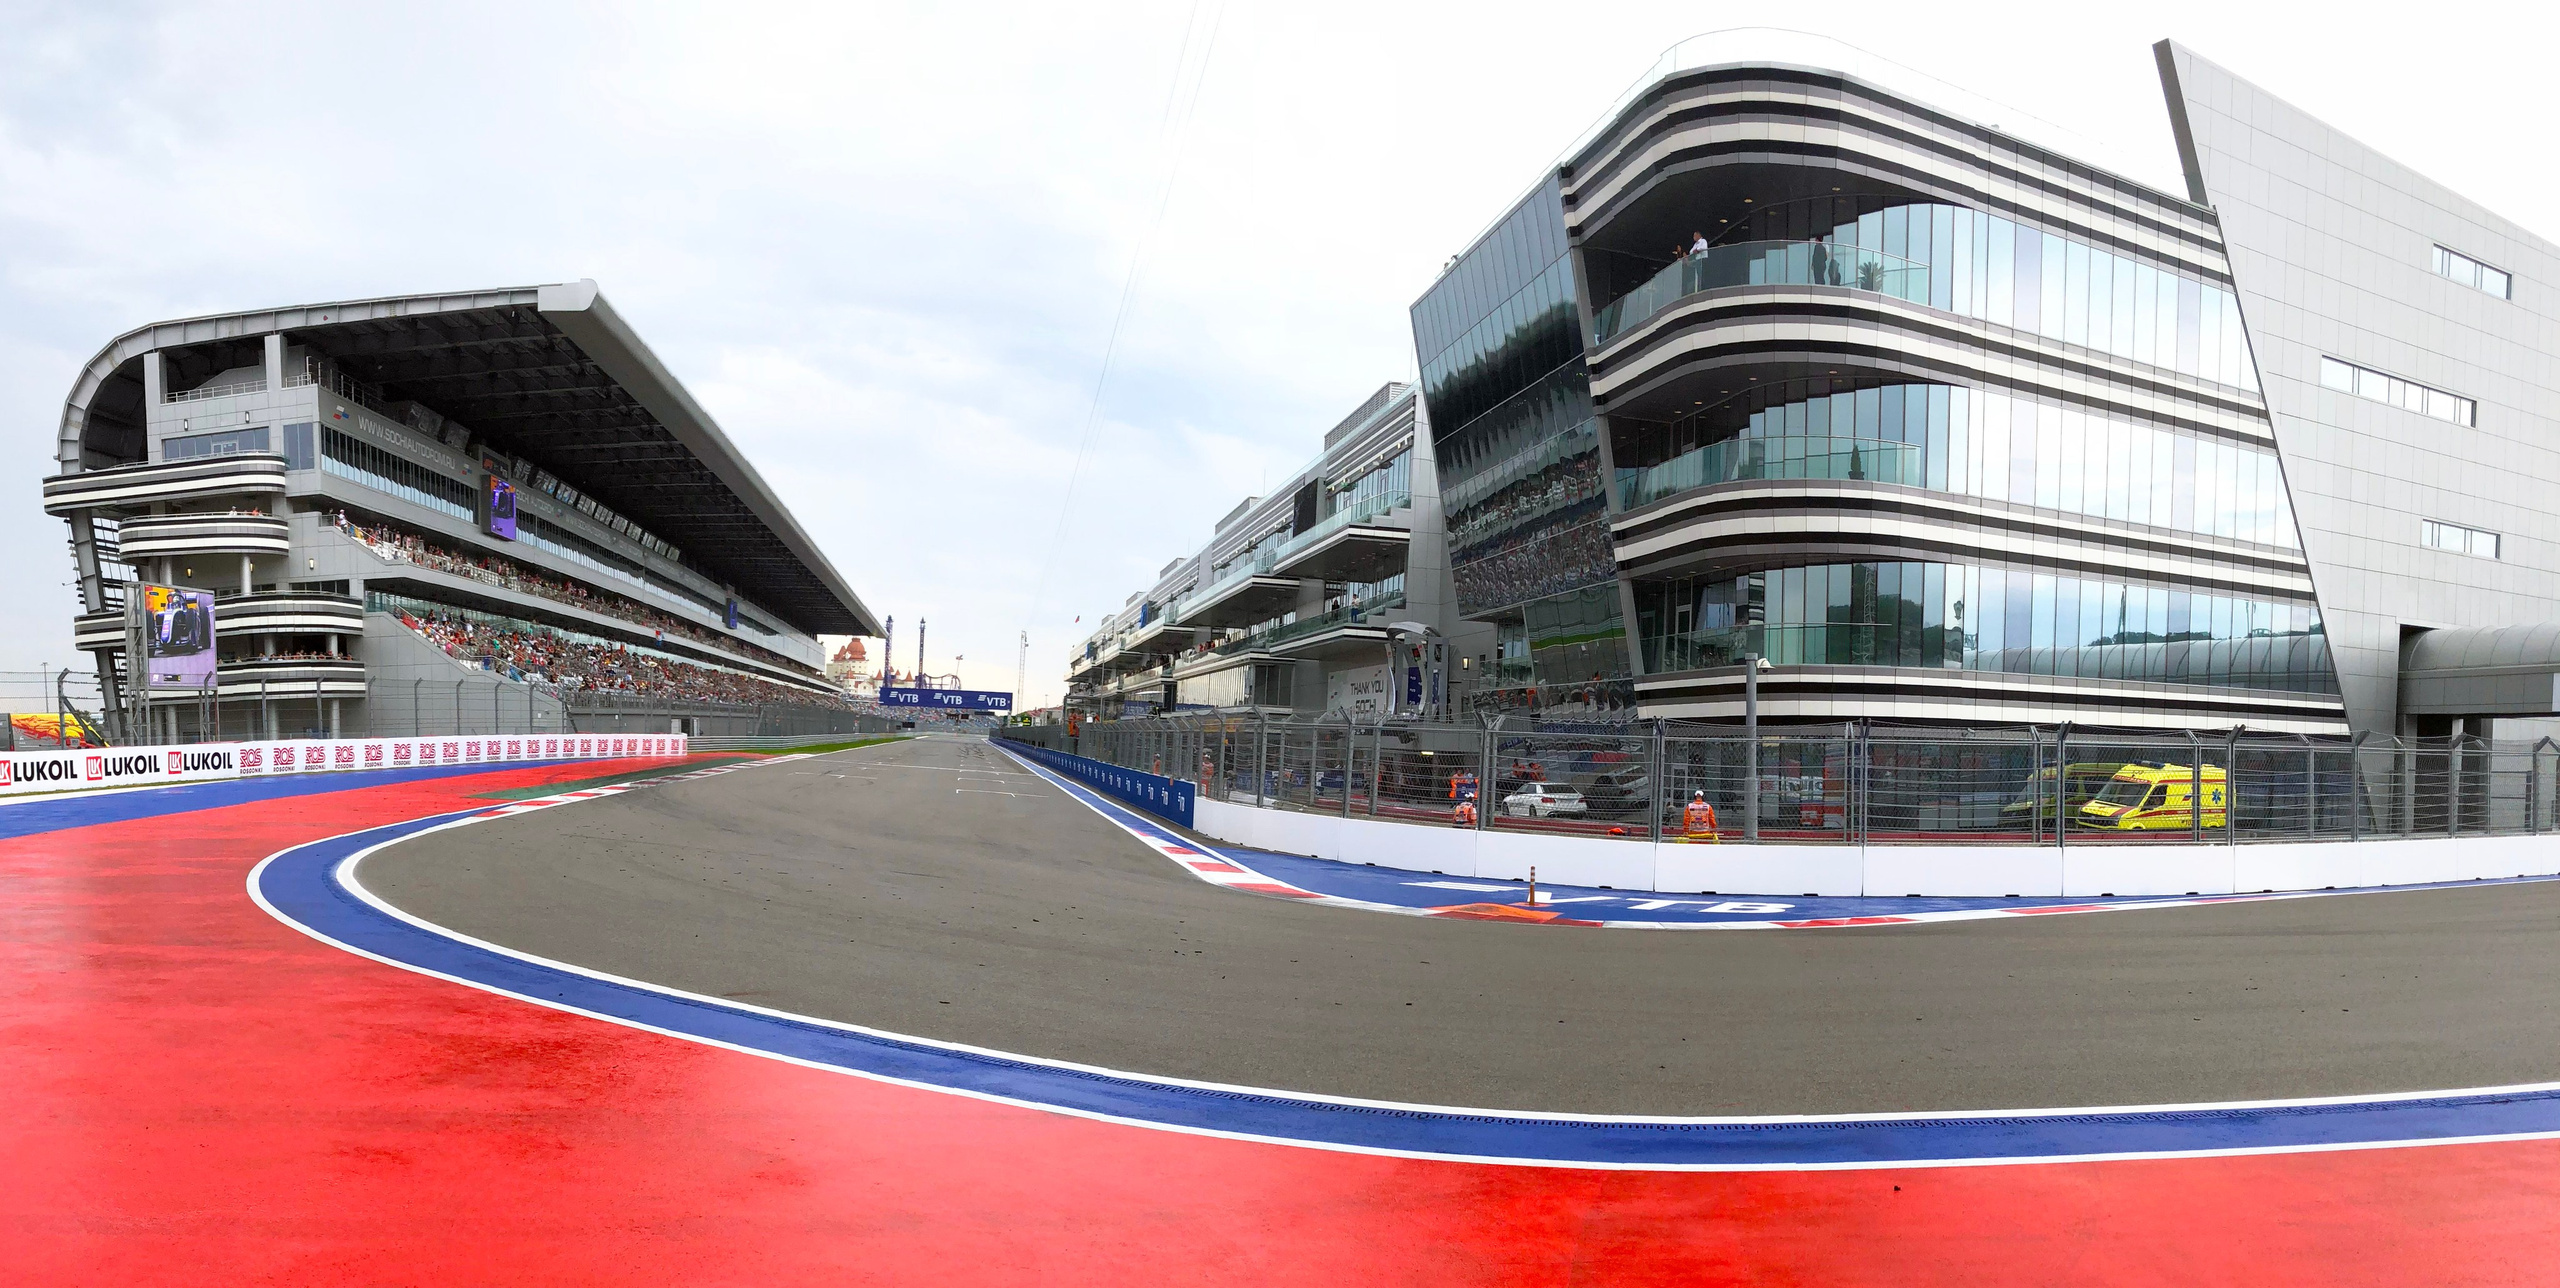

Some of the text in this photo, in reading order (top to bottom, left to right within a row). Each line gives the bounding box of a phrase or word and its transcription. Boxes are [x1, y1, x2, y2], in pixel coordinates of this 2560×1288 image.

[1350, 680, 1384, 695] THANK YOU
[898, 693, 919, 703] VTB
[942, 695, 963, 705] VTB
[986, 697, 1007, 707] VTB
[183, 752, 233, 771] LUKOIL
[240, 748, 263, 767] ROS
[273, 747, 295, 766] ROS
[305, 746, 326, 764] ROS
[335, 745, 355, 763] ROS
[14, 760, 78, 782] LUKOIL
[104, 755, 160, 776] LUKOIL
[1526, 891, 1796, 914] VTB
